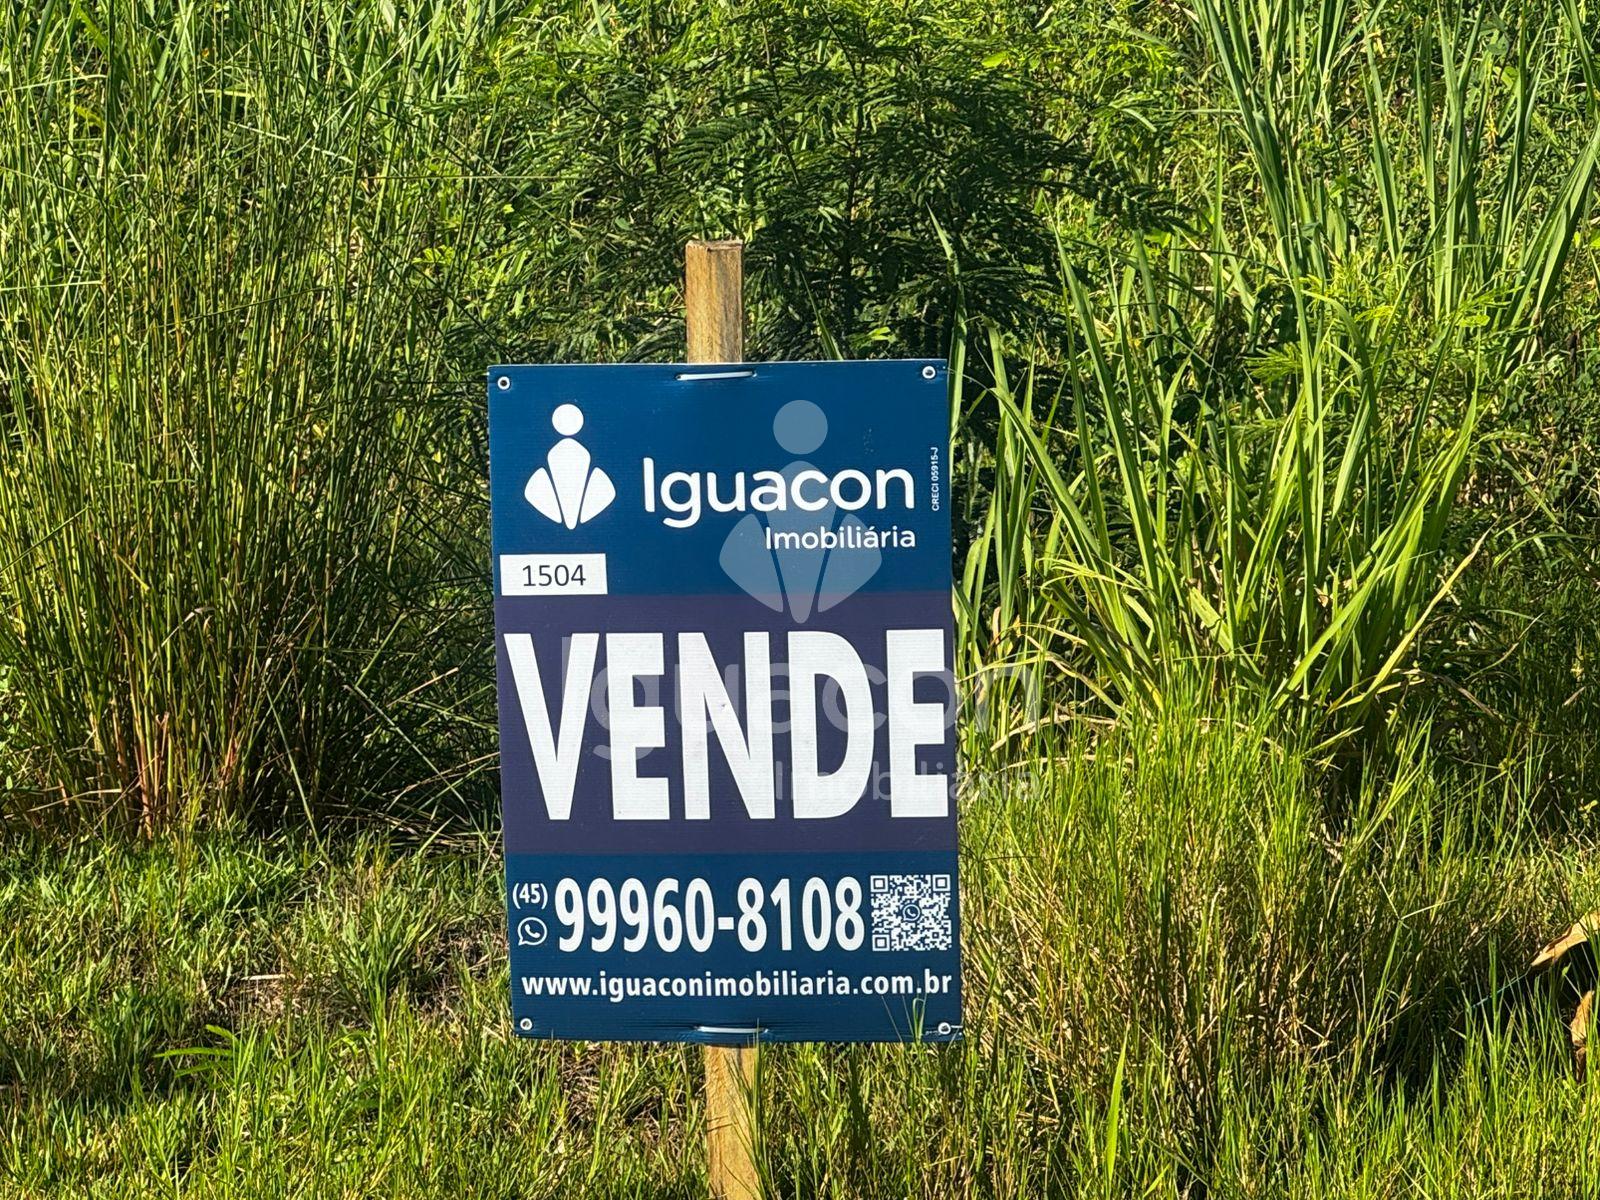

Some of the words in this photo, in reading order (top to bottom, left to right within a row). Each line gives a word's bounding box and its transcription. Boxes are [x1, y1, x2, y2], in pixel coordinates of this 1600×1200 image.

[930, 446, 940, 482] 05915-J
[643, 457, 915, 529] Iguacon
[931, 482, 940, 512] CRECI
[765, 526, 916, 550] Imobiliária
[522, 563, 587, 588] 1504
[503, 628, 950, 821] VENDE
[512, 883, 549, 910] (45)
[554, 876, 866, 953] 99960-8108
[521, 968, 953, 1003] www.iguaconimobiliaria.com.br
